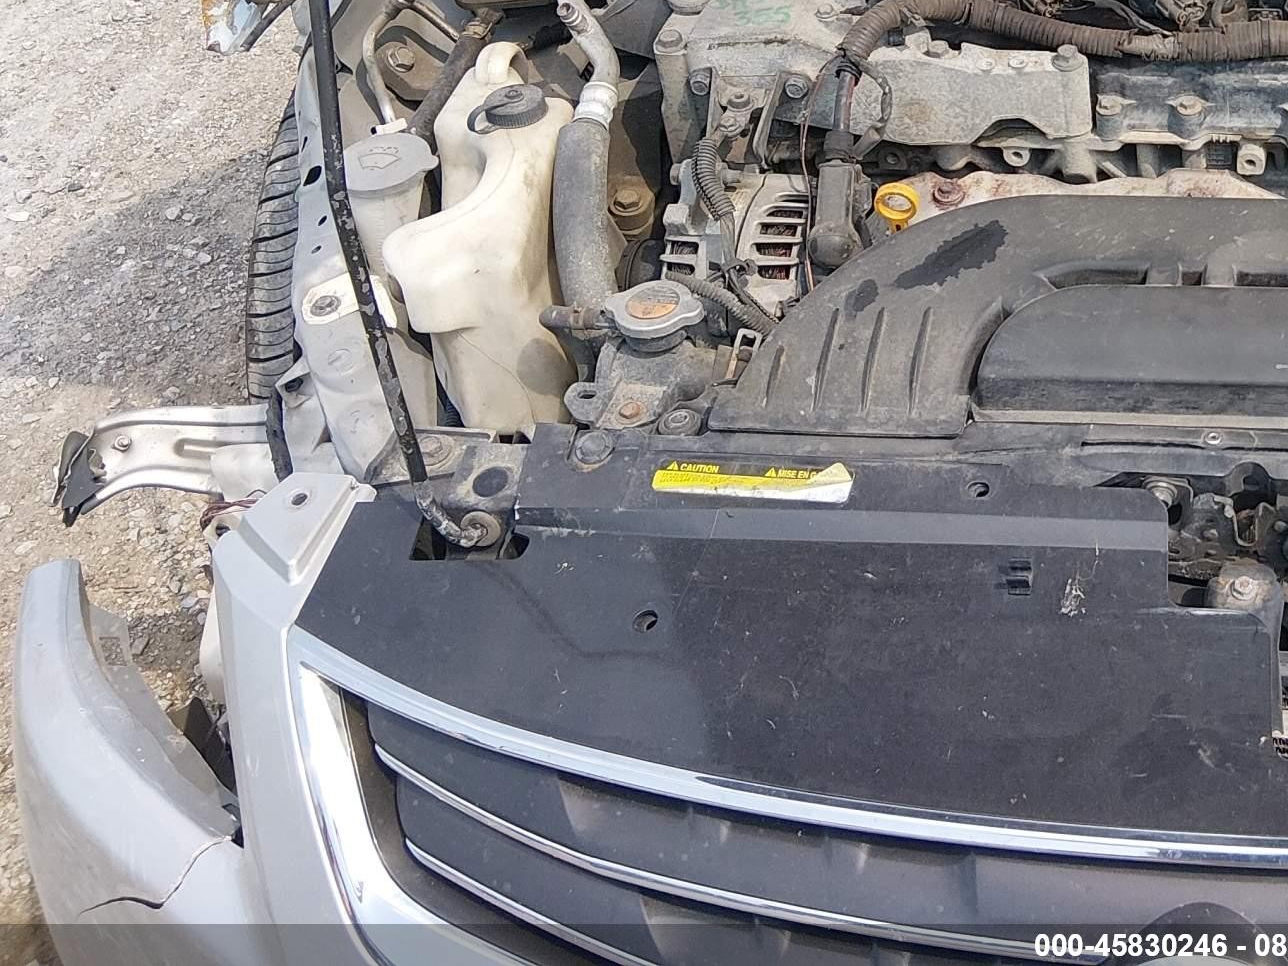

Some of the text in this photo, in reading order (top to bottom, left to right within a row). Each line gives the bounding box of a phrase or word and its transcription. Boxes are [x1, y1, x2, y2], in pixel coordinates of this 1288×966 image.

[680, 463, 720, 474] CAUTION
[777, 469, 797, 479] MISE
[797, 470, 809, 479] EN
